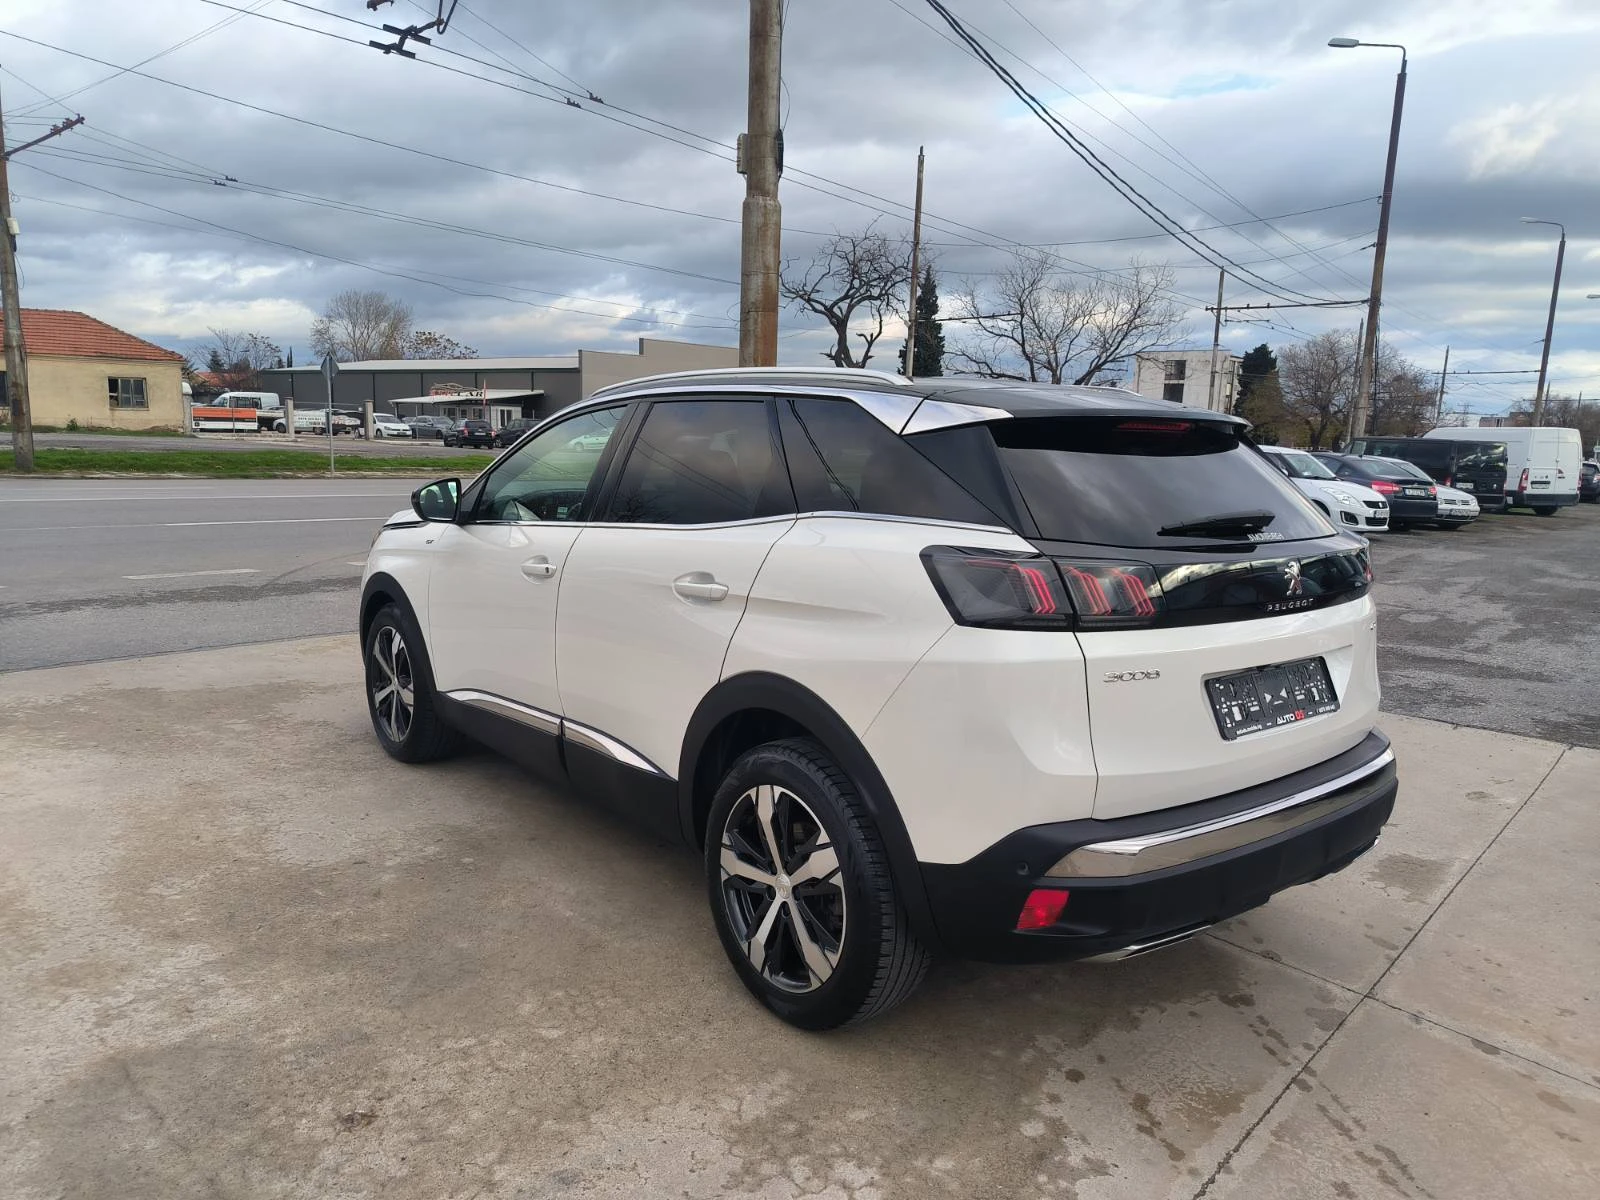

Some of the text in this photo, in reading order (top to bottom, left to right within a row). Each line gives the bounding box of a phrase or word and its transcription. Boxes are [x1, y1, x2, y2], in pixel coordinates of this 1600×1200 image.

[1266, 598, 1314, 612] PEUGEOT
[1103, 668, 1161, 683] 3008
[1276, 712, 1295, 725] AUTO
